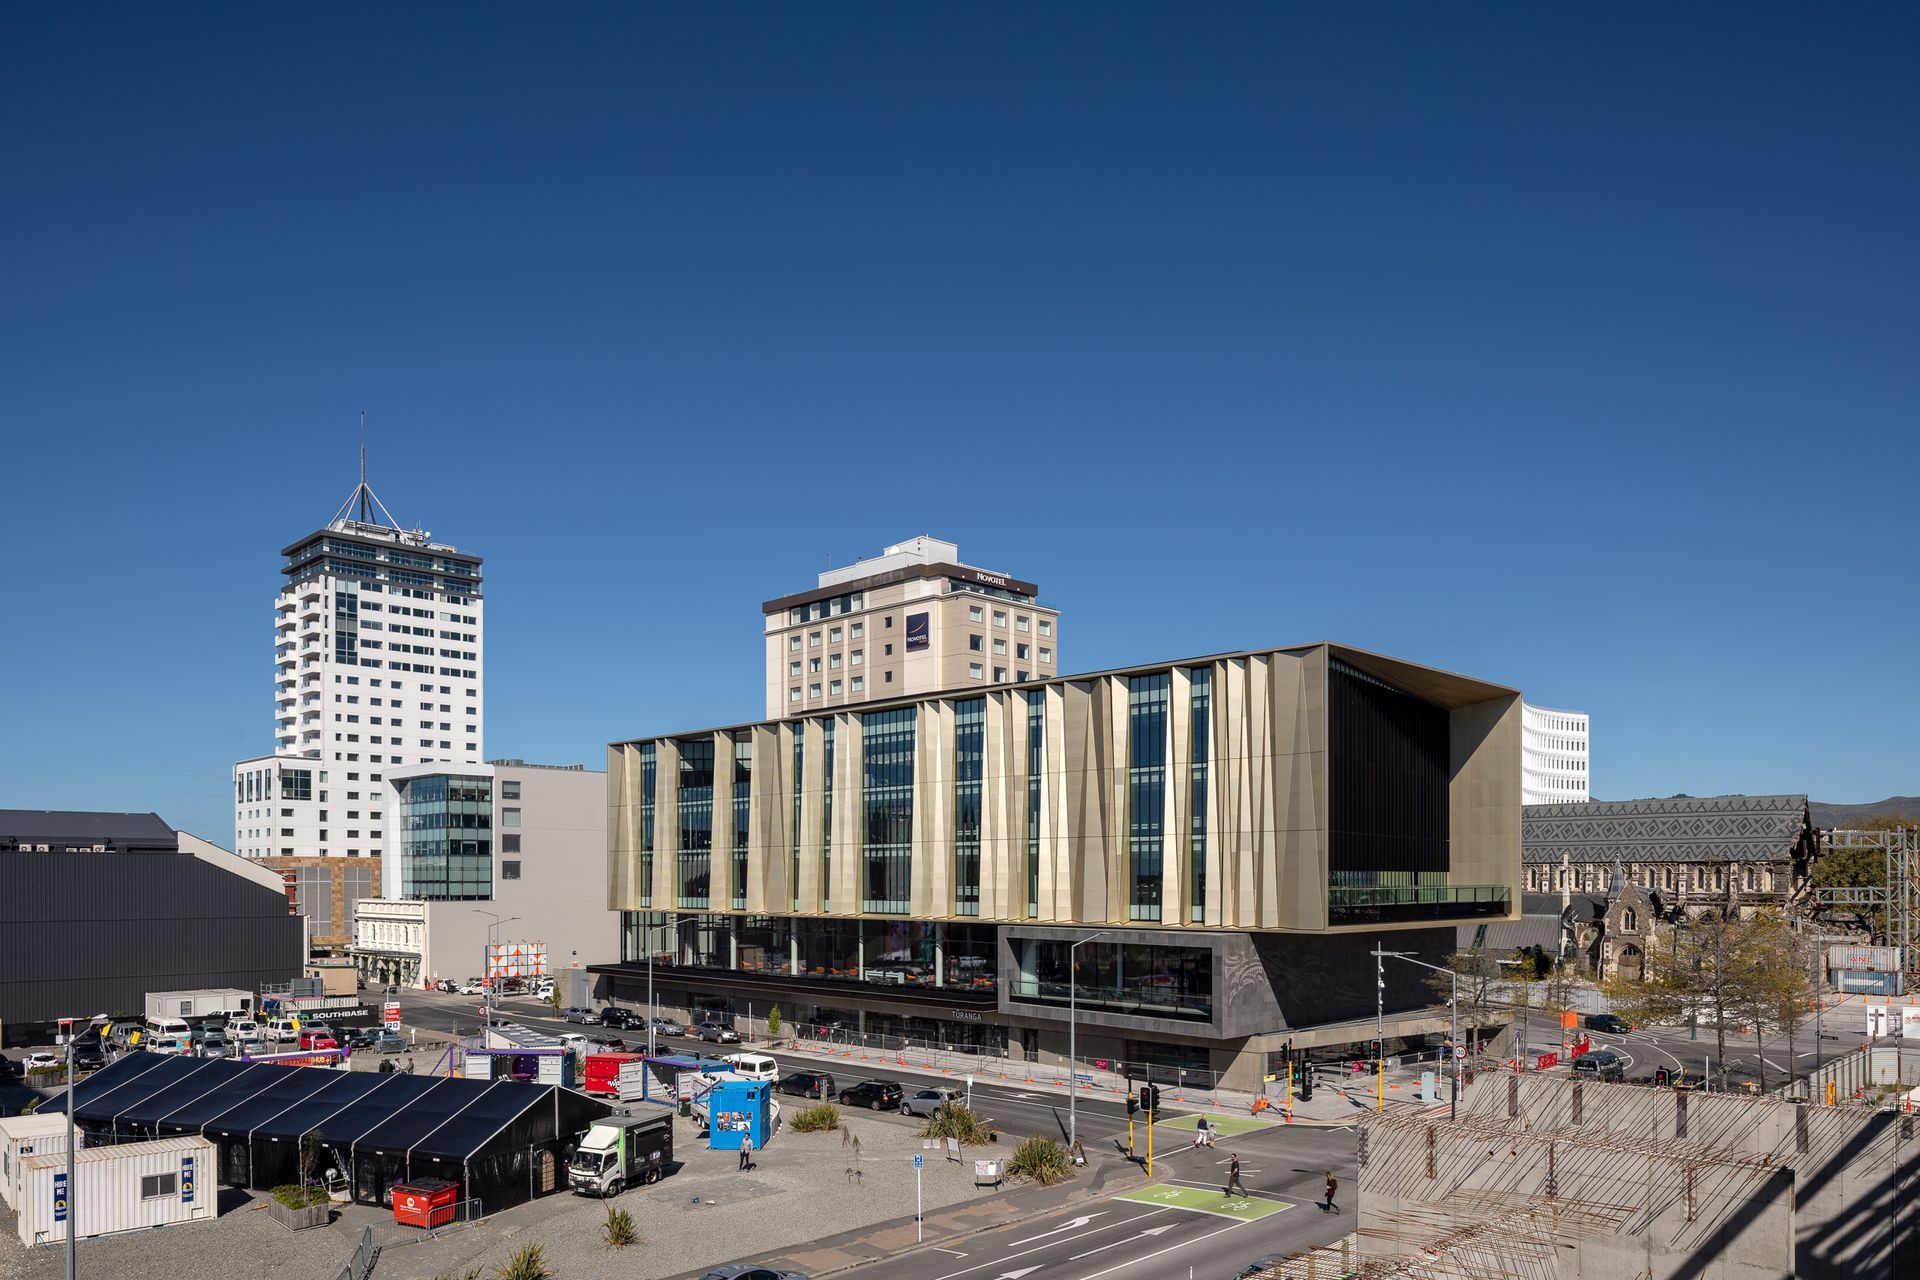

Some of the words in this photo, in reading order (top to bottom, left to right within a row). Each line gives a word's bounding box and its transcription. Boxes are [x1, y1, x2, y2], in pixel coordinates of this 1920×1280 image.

[976, 572, 1007, 586] NOVOTEL
[907, 634, 928, 642] NOVOTEL
[1850, 955, 1872, 963] ANL
[312, 1009, 369, 1020] SOUTHBASE
[1456, 1048, 1465, 1056] 30
